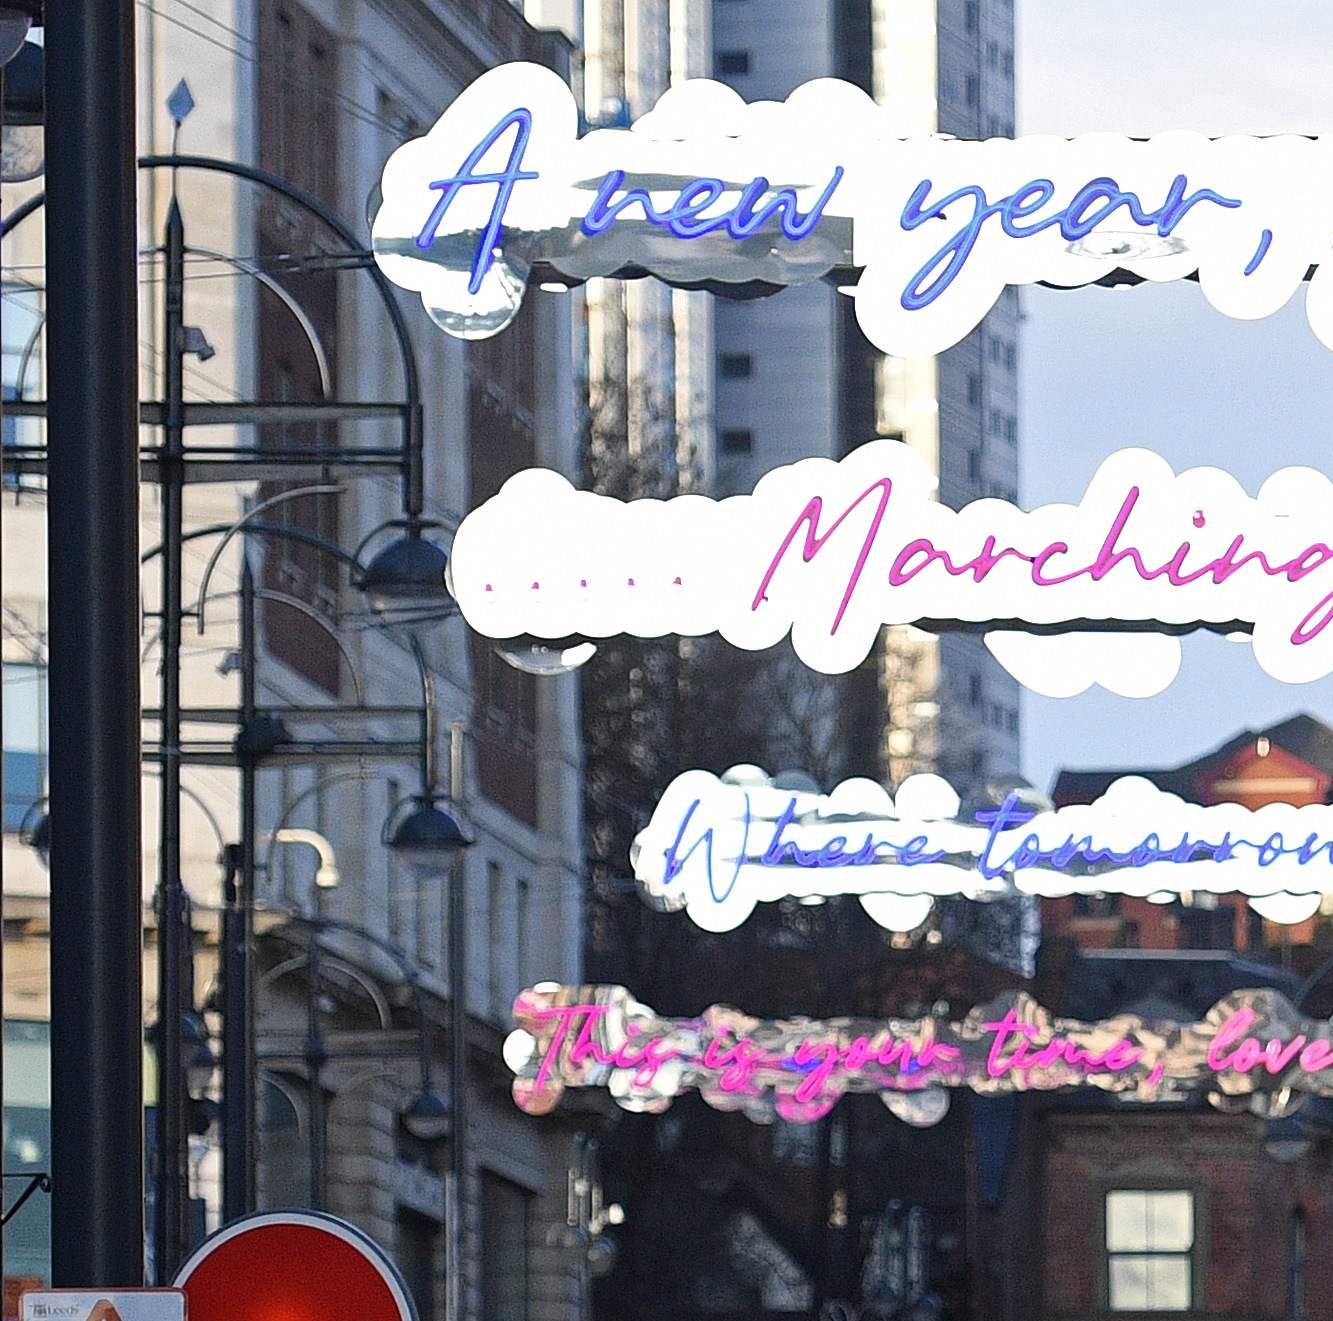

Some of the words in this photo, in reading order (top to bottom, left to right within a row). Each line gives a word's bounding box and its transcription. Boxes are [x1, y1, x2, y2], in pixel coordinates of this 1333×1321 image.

[415, 108, 538, 293] A
[578, 164, 843, 240] new
[900, 172, 1272, 312] year,
[663, 796, 947, 905] Where
[516, 1002, 695, 1090] This
[701, 1019, 785, 1088] is
[793, 1027, 959, 1103] your
